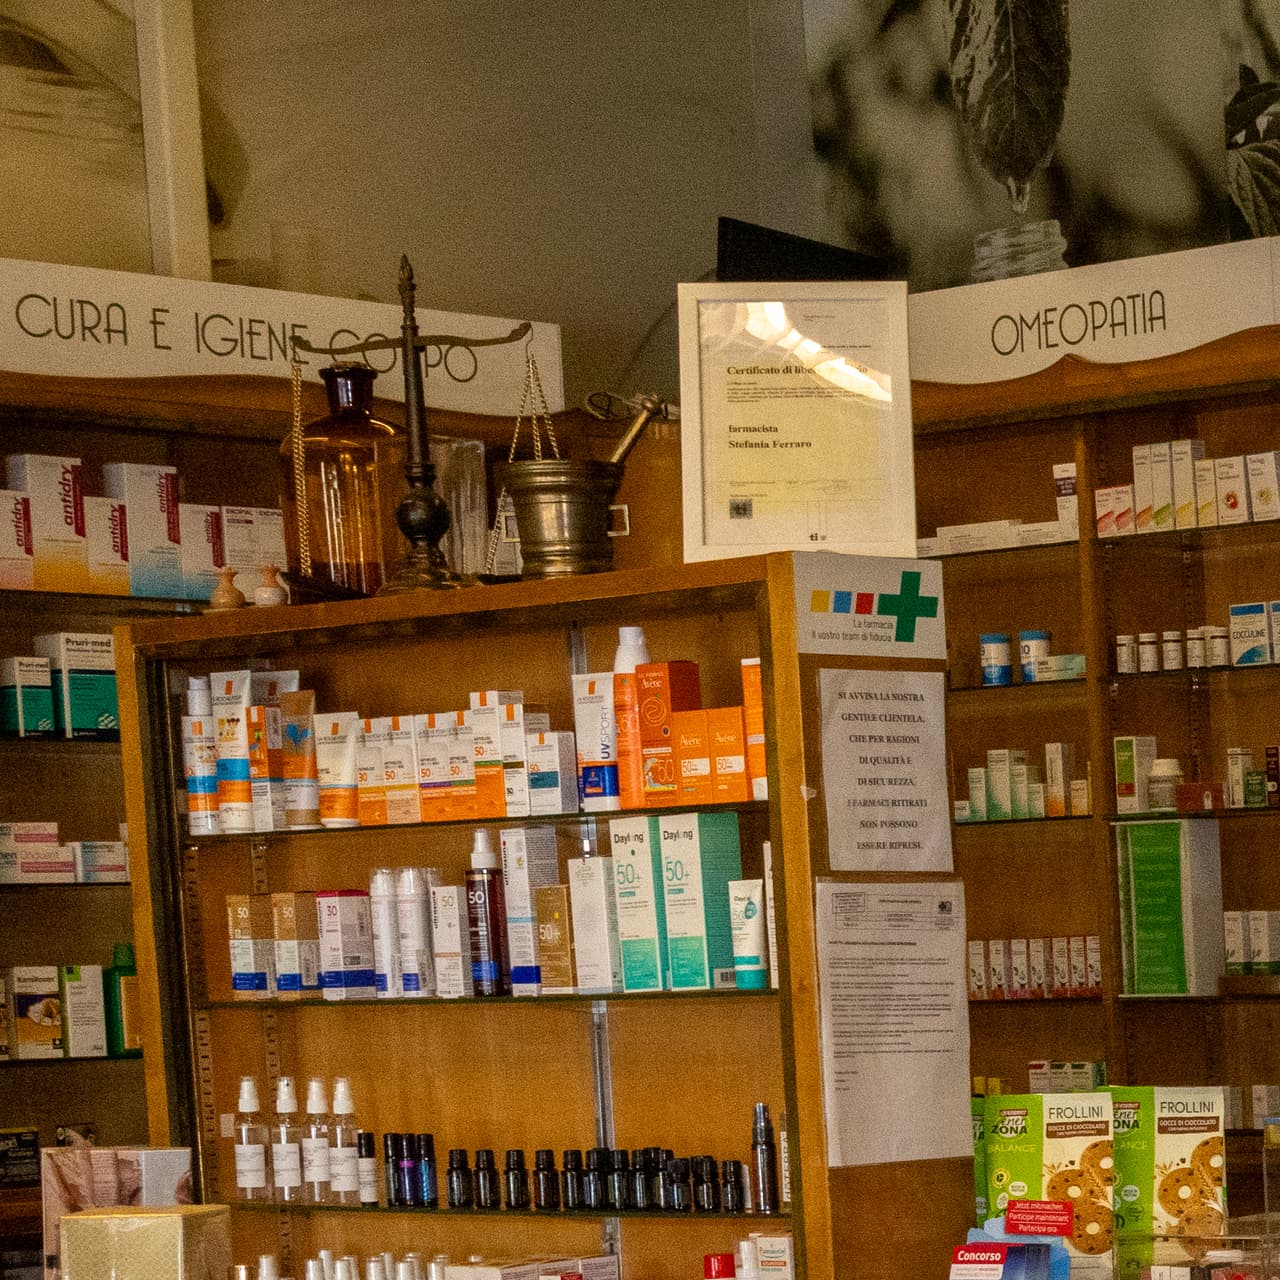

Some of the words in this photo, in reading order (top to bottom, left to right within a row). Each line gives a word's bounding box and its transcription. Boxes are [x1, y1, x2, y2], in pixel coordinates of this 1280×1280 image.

[991, 290, 1167, 356] OMEOPATIA
[16, 294, 127, 347] CURA
[152, 308, 171, 350] E
[195, 313, 309, 364] IGIENE
[331, 329, 478, 383] COPO
[727, 365, 783, 376] Certificato
[786, 365, 795, 375] di
[728, 424, 778, 434] farmacista
[728, 440, 769, 450] Stefania
[772, 440, 812, 450] Ferraro
[58, 463, 74, 526] antidry
[864, 620, 893, 629] farmacia
[65, 637, 112, 649] Pruri-med
[869, 633, 891, 642] fiducia
[1049, 1106, 1103, 1119] FROLLINI
[1160, 1101, 1215, 1114] FROLLINI
[958, 1250, 1001, 1262] Concorso
